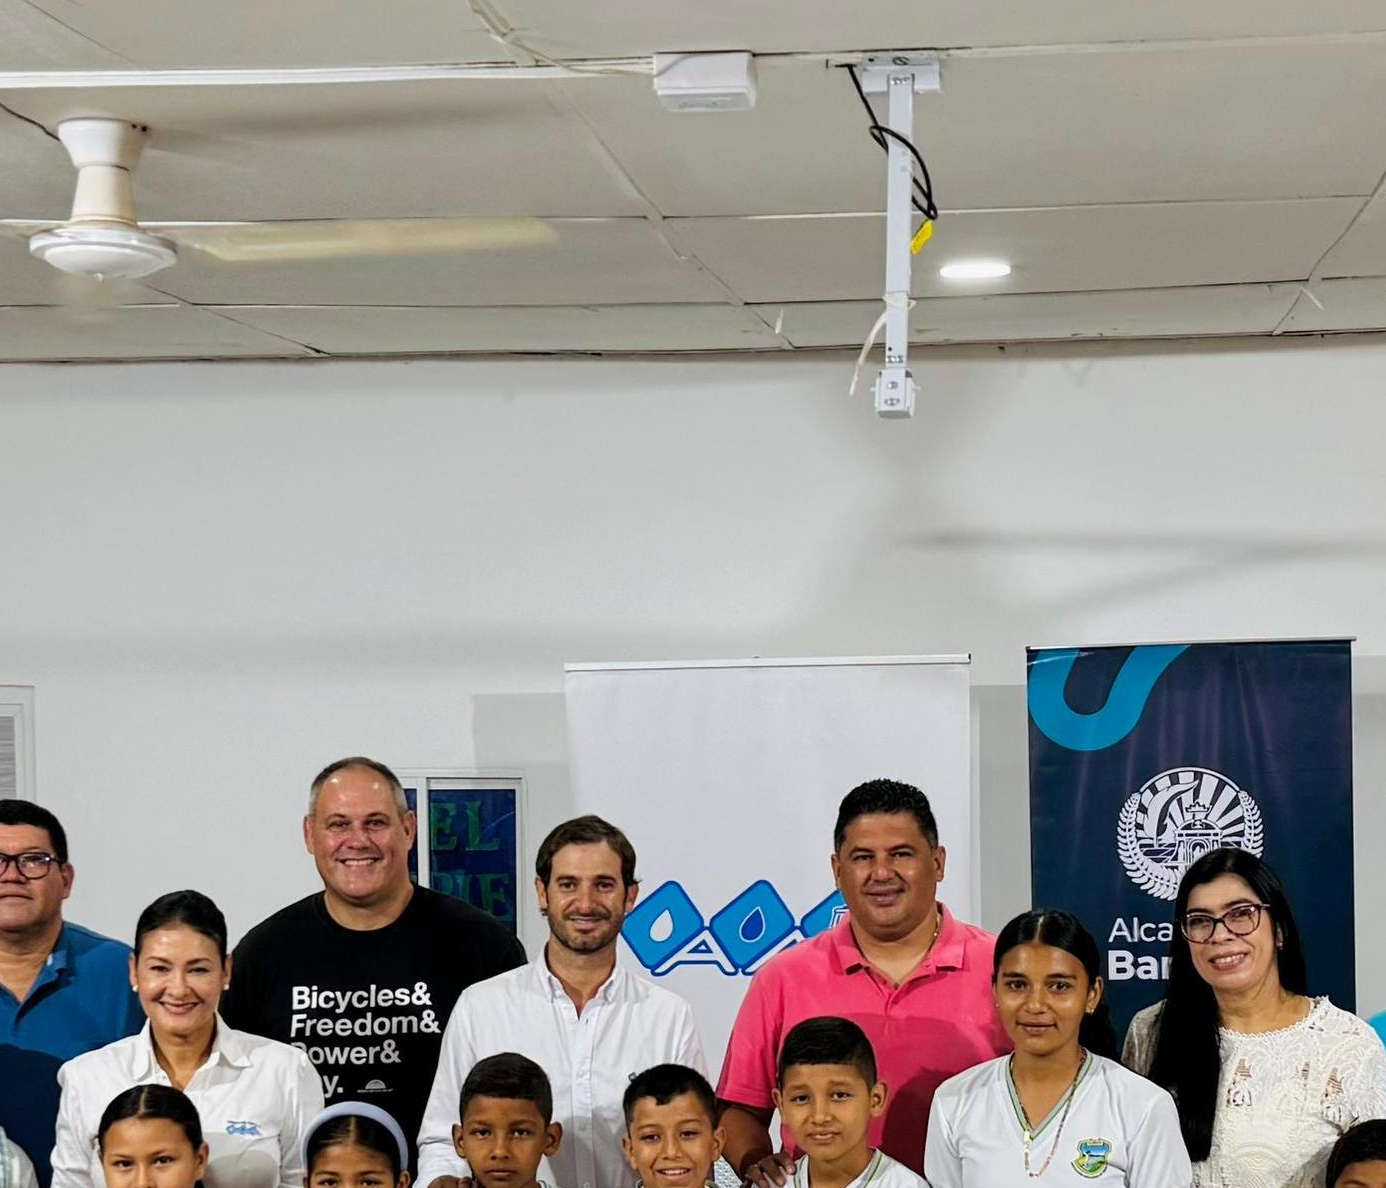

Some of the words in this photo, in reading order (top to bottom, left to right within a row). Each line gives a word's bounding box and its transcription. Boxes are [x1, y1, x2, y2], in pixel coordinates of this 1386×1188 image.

[1108, 917, 1173, 943] Alca
[1108, 949, 1173, 981] Bar
[292, 981, 433, 1014] Bicycles&
[290, 1009, 442, 1038] Freedom&
[322, 1075, 344, 1099] y.
